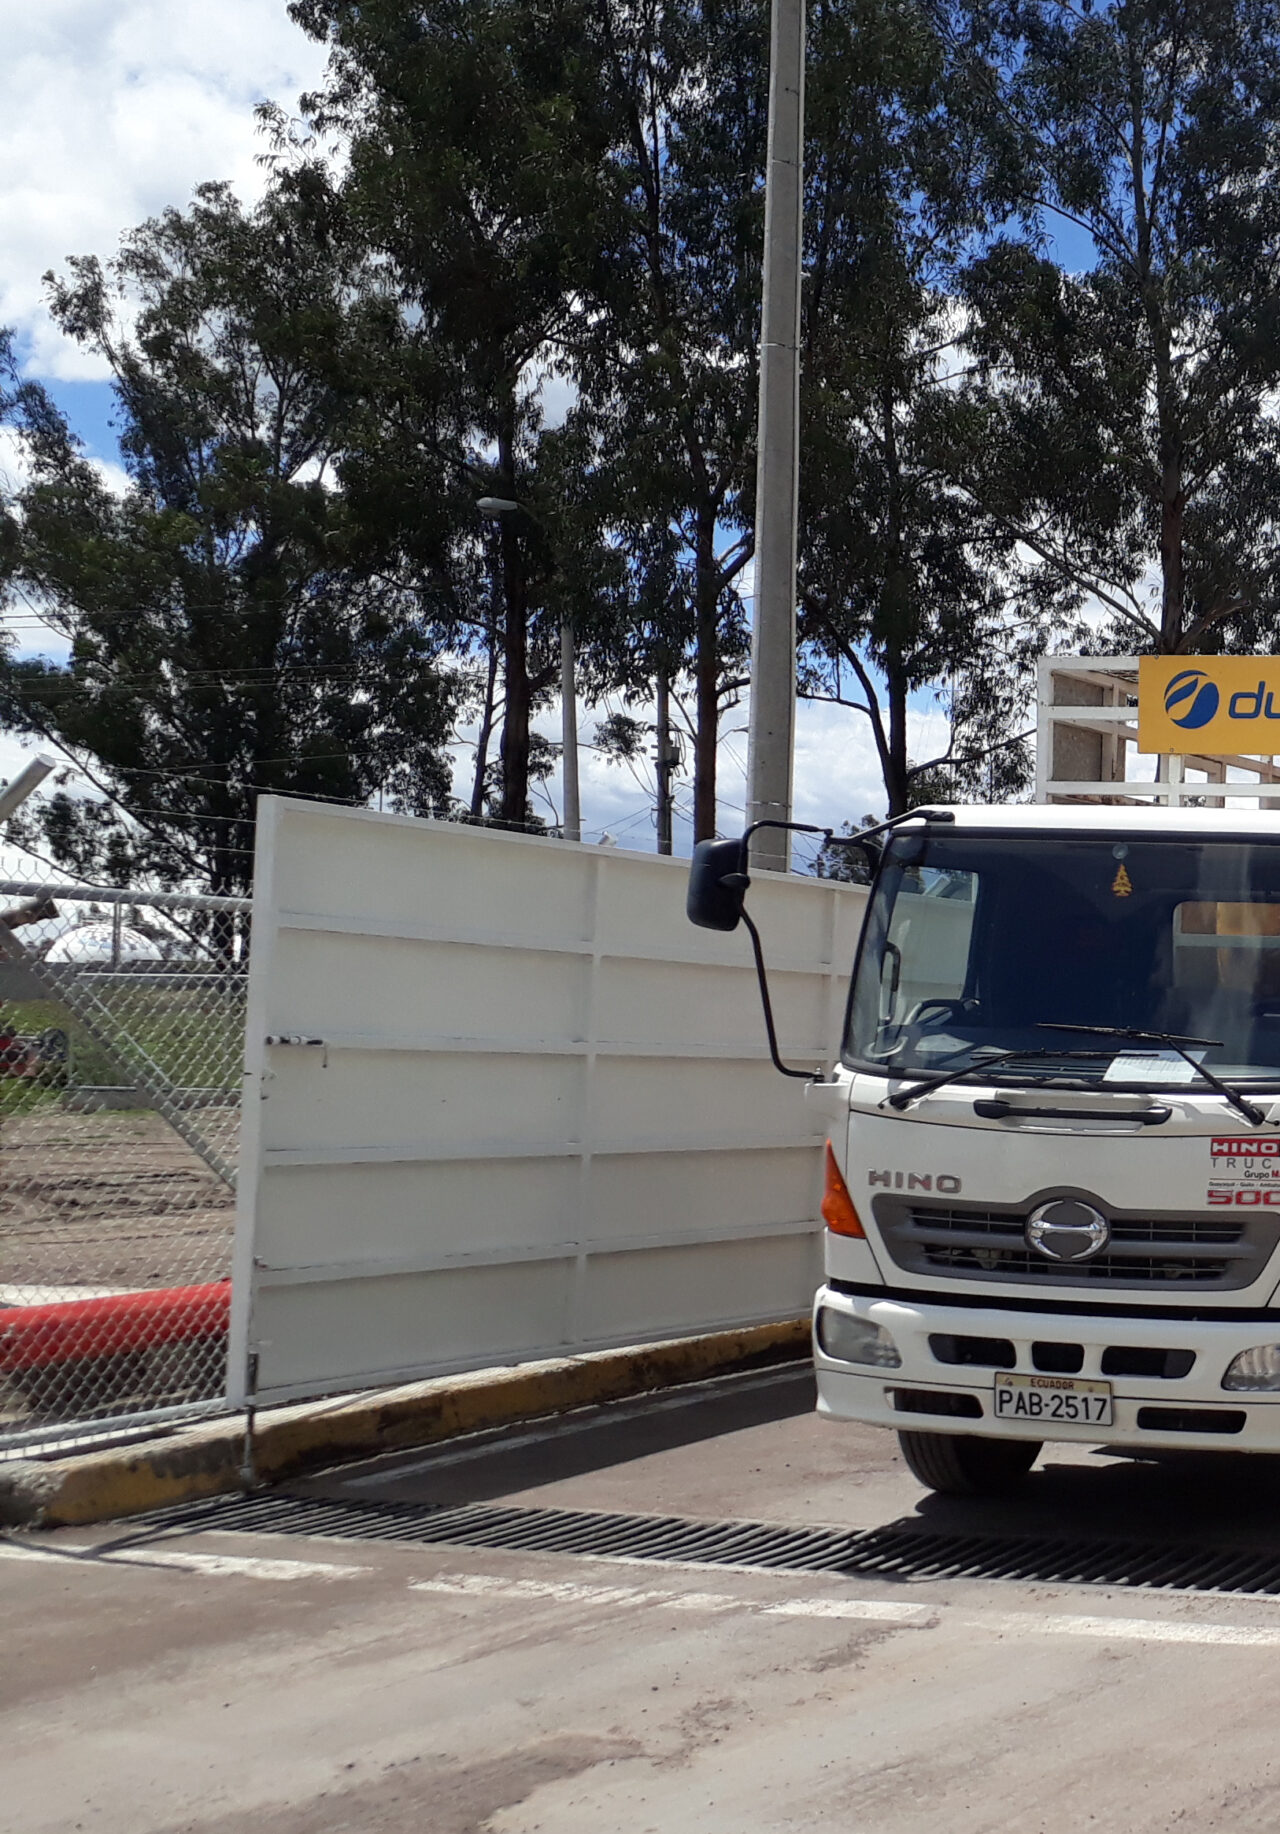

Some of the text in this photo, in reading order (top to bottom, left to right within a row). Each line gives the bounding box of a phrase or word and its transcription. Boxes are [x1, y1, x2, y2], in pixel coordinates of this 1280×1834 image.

[1212, 1142, 1278, 1153] HINO
[867, 1168, 962, 1193] HINO
[1244, 1170, 1270, 1179] Grupo
[1030, 1377, 1074, 1390] ECUADOR
[998, 1389, 1107, 1421] PAB-2517
